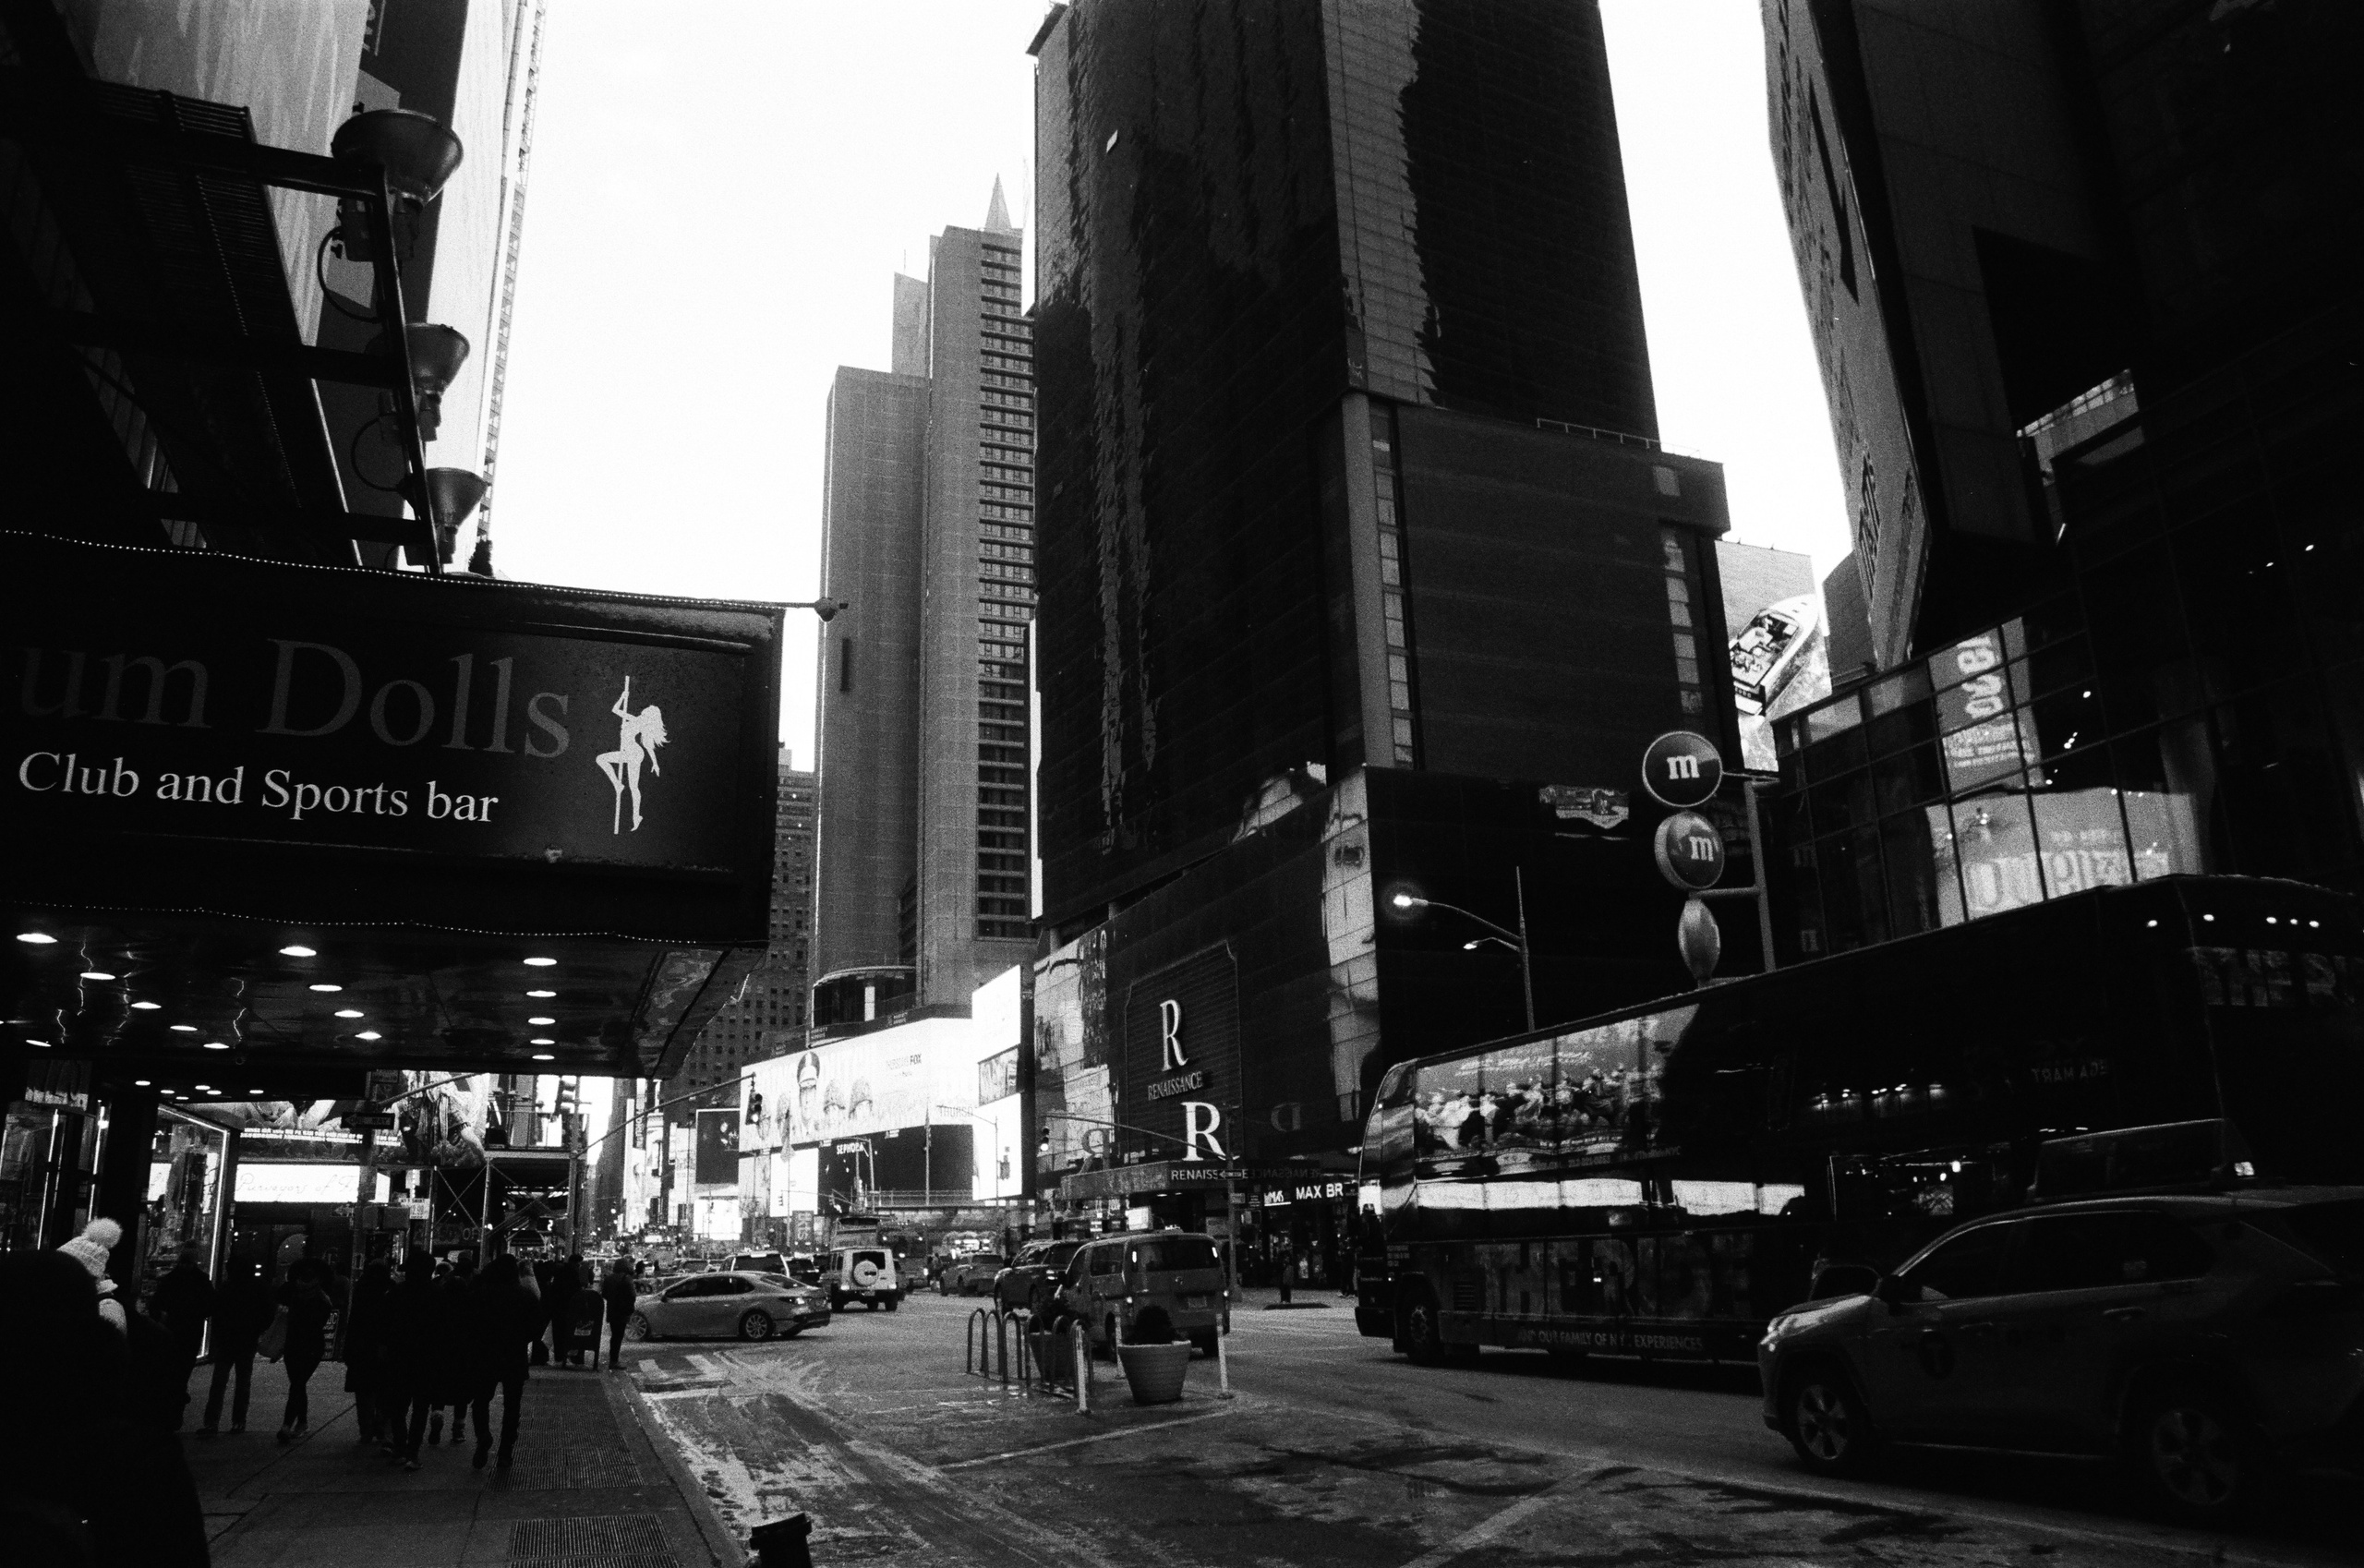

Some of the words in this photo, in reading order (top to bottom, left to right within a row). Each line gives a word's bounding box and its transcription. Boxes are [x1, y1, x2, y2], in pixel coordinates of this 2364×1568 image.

[2, 645, 212, 729] um
[255, 638, 570, 758] Dolls
[1666, 754, 1699, 779] m
[18, 752, 140, 797] Club
[156, 766, 245, 804] and
[261, 769, 408, 821] Sports
[426, 780, 499, 822] bar
[1688, 835, 1715, 862] m
[1159, 999, 1189, 1072] R
[1148, 1071, 1203, 1101] RENAISSANCE
[1180, 1102, 1240, 1161] R
[836, 1141, 865, 1155] SEPHORA
[1171, 1168, 1248, 1181] RENAISSE
[1296, 1185, 1322, 1200] MAX
[1538, 1330, 1558, 1345] OUR
[1560, 1331, 1592, 1345] FAMILY
[1595, 1333, 1607, 1346] OF
[1634, 1334, 1704, 1352] EXPERIENCES
